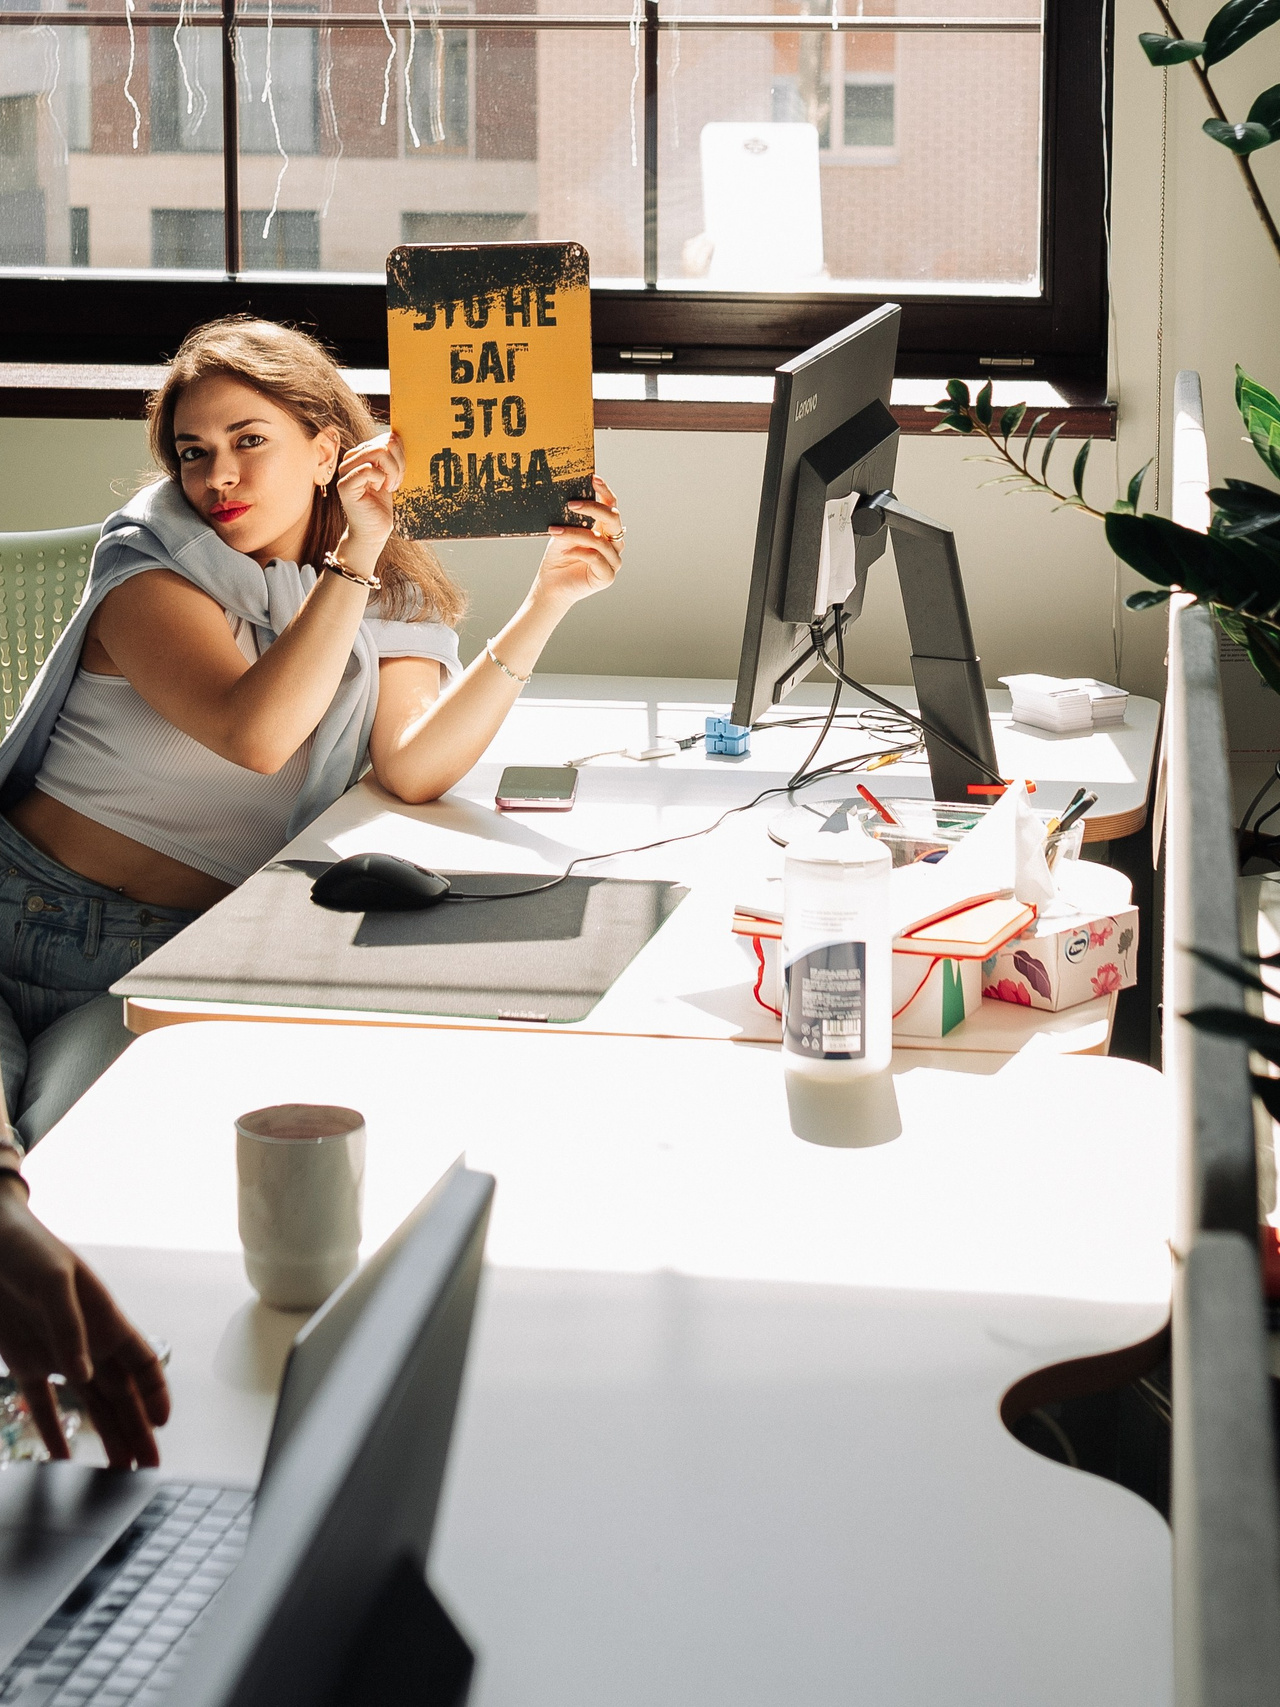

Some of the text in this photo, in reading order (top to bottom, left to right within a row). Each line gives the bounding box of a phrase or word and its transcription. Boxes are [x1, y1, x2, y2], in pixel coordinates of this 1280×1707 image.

[505, 286, 557, 327] НЕ
[450, 341, 529, 384] БАГ
[450, 396, 527, 439] ЭТО
[794, 393, 818, 423] Lenovo
[429, 448, 552, 496] ФИЧА
